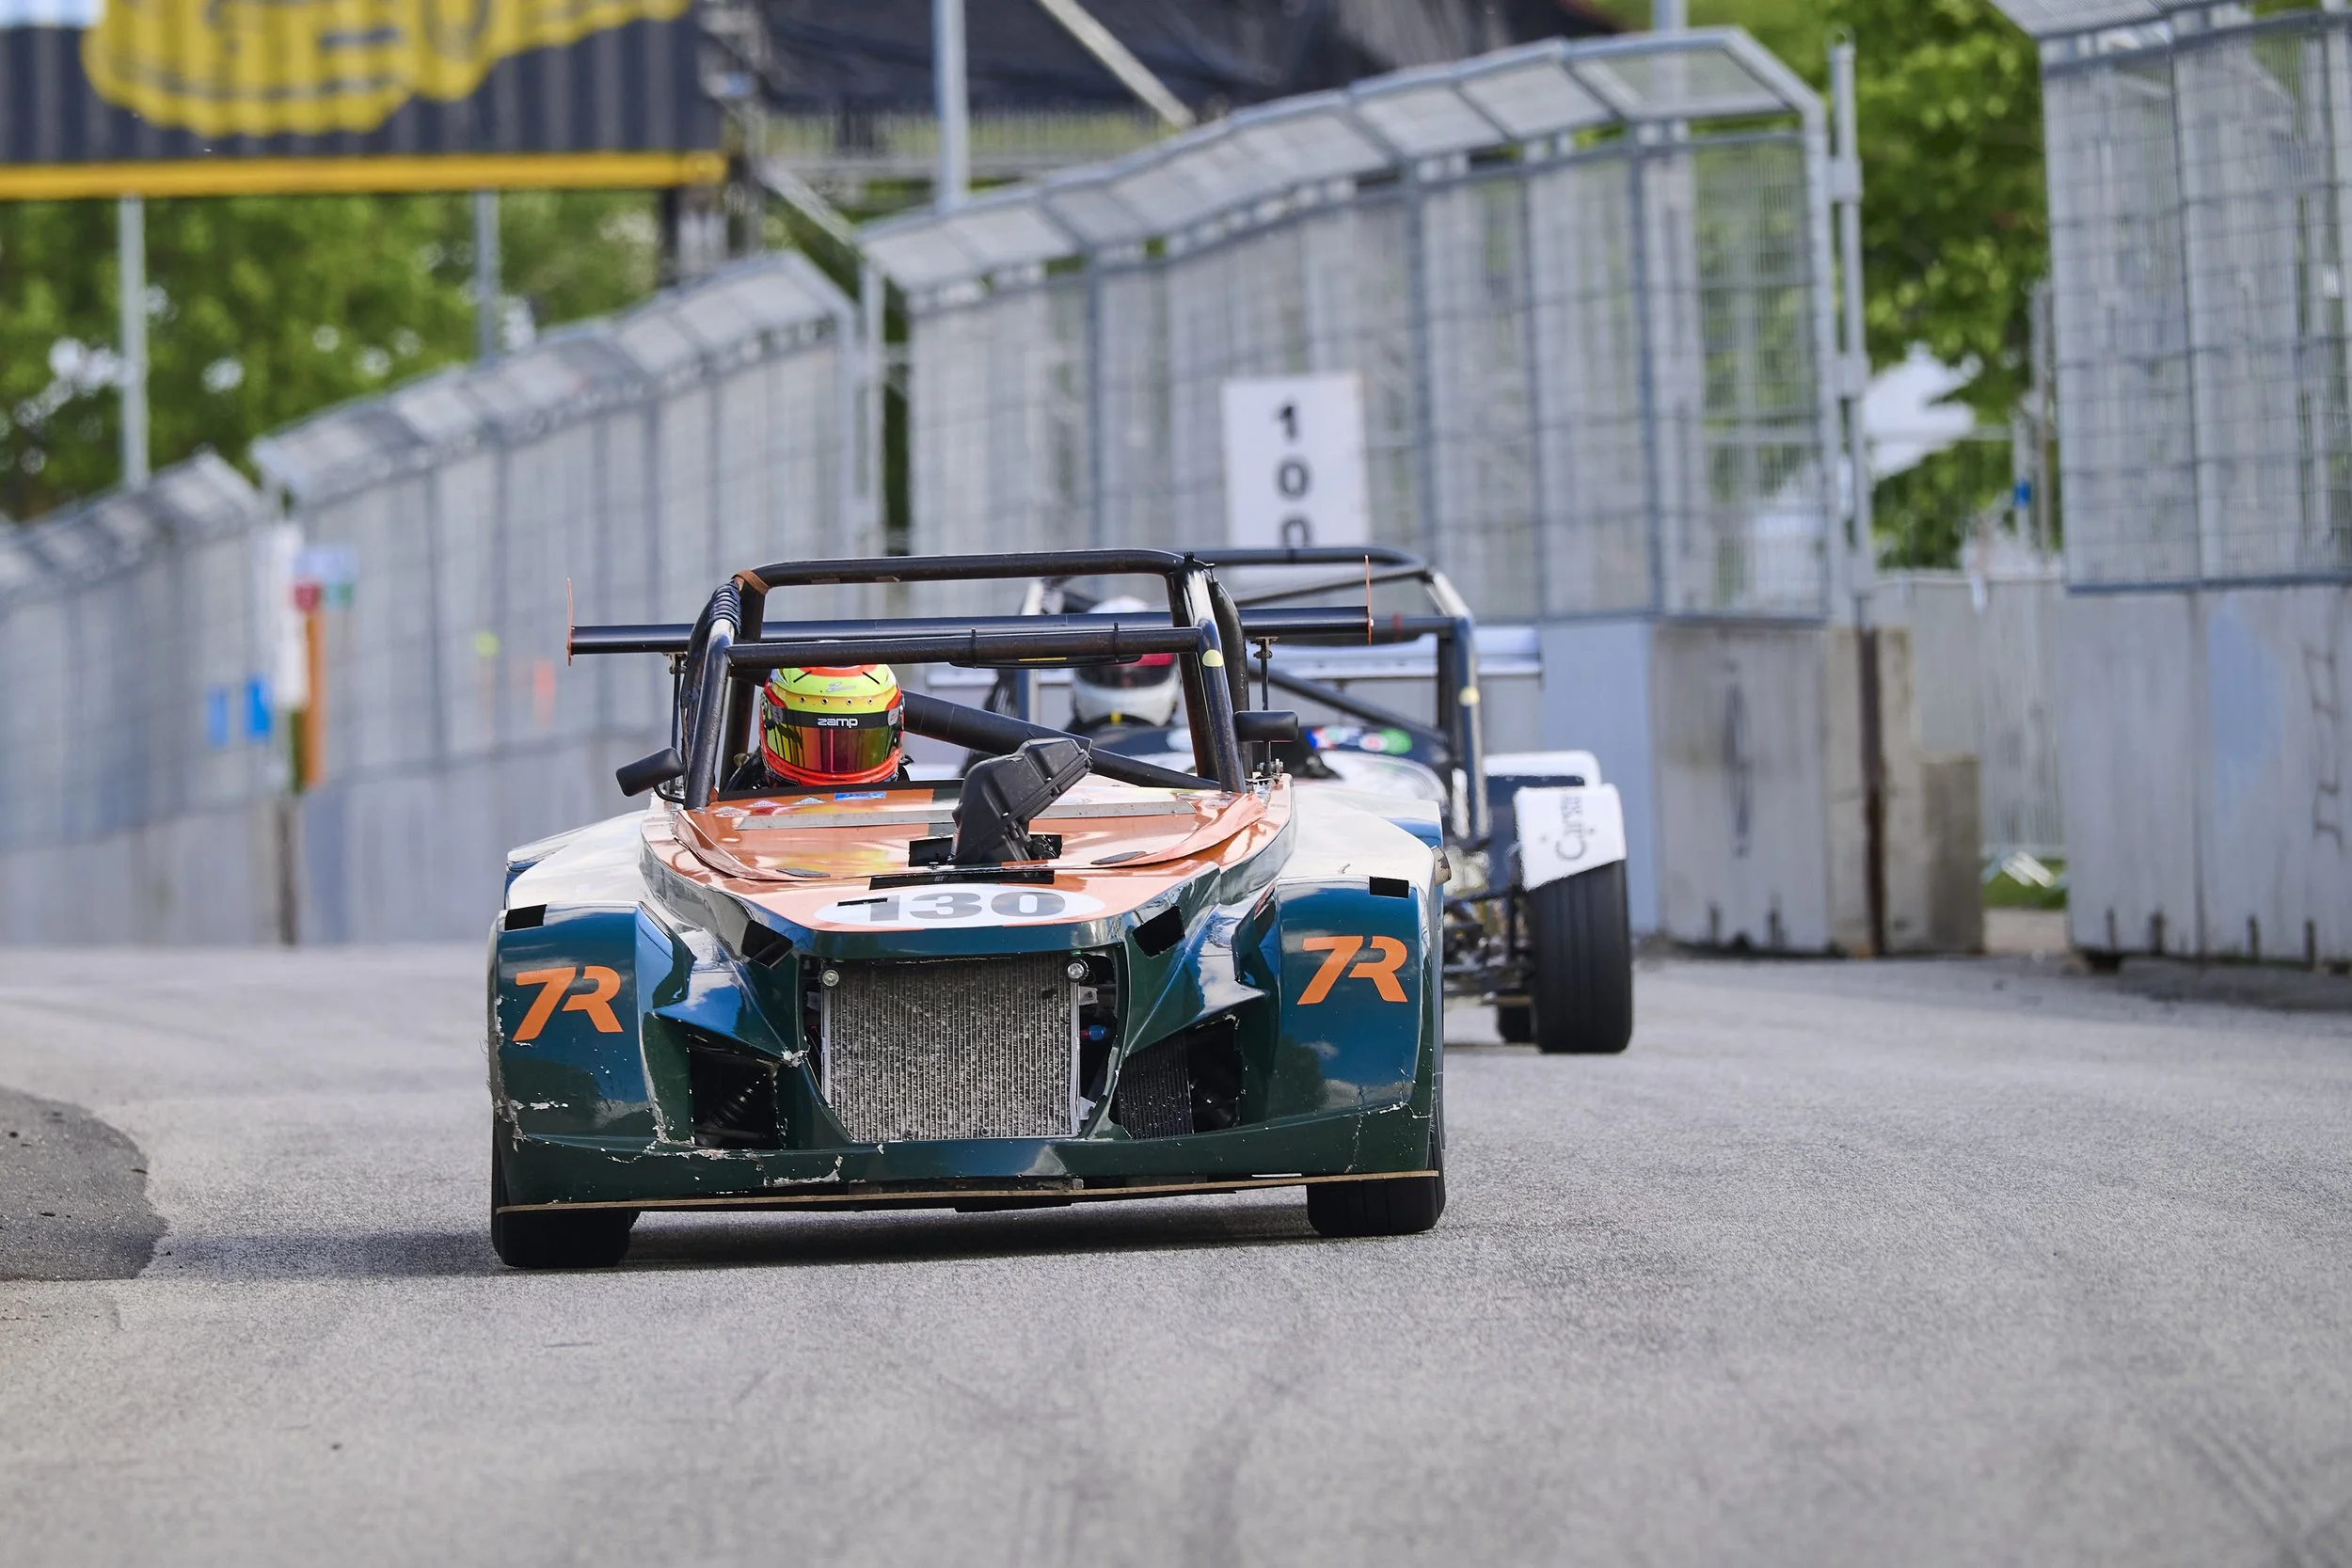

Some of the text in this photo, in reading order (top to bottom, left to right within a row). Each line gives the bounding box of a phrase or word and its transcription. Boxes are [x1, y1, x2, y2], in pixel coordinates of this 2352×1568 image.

[817, 718, 859, 729] zamp
[838, 891, 1066, 923] 130
[1296, 935, 1408, 1006] 7R
[511, 965, 624, 1042] 7R
